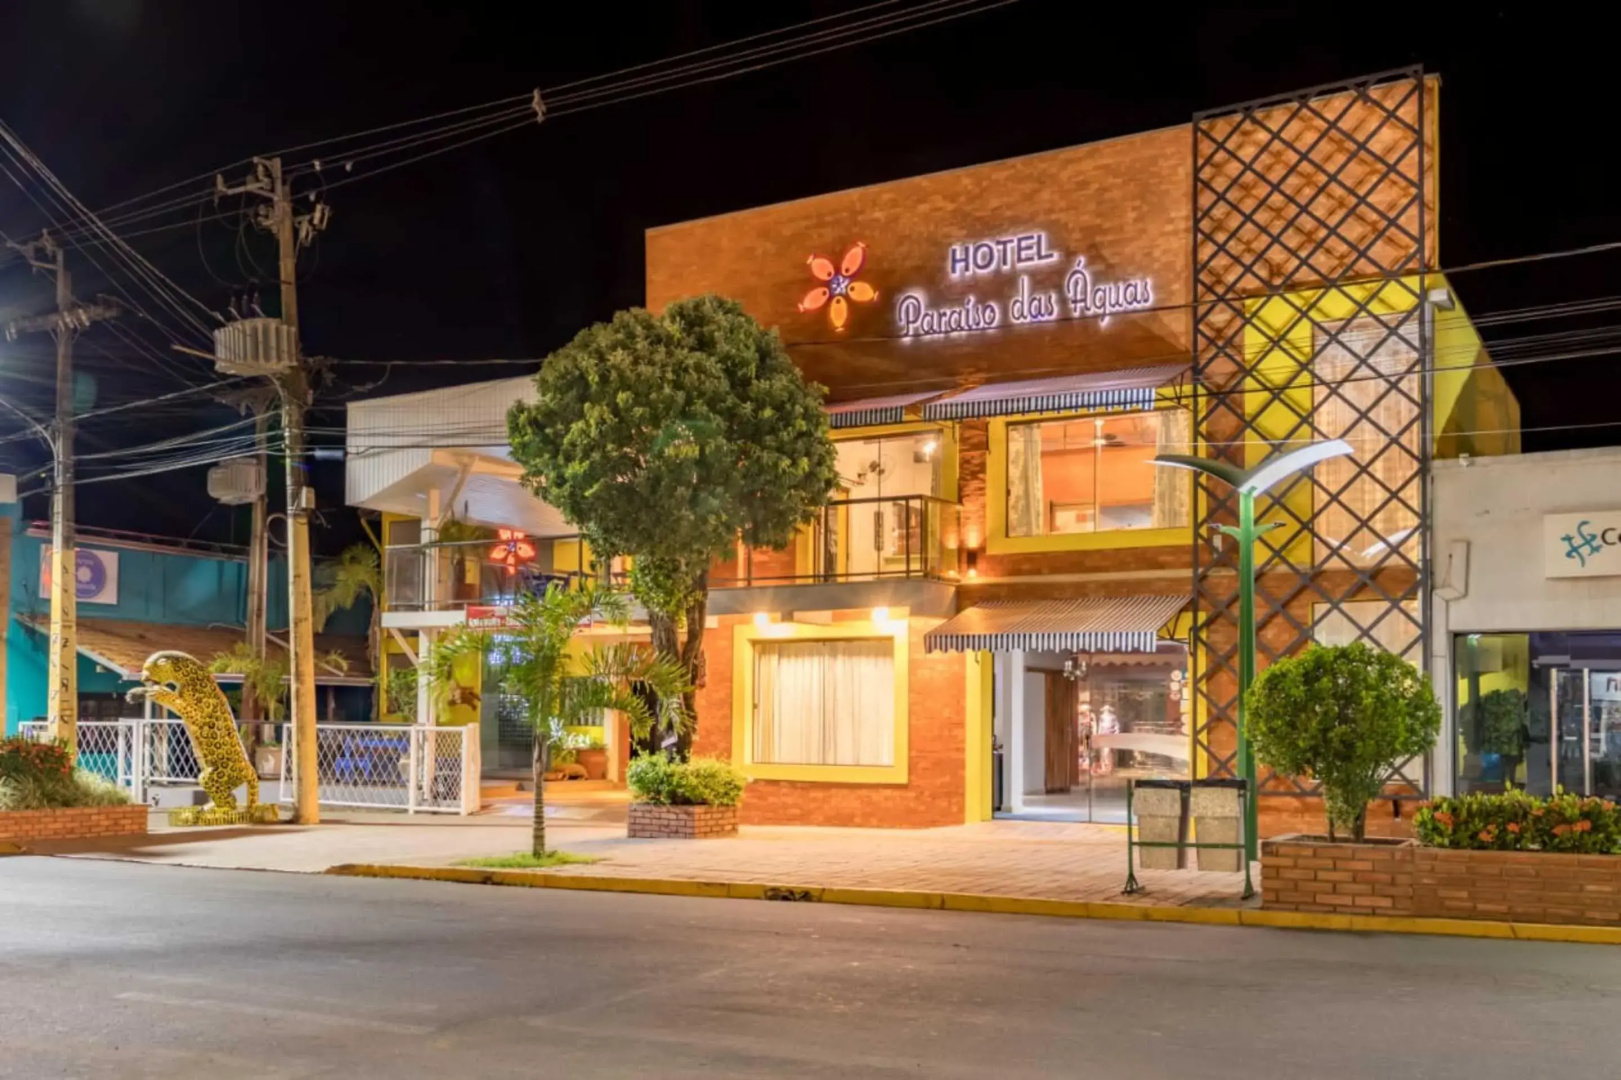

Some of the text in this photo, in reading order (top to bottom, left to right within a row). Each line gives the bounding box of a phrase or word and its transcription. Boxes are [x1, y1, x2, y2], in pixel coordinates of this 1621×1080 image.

[950, 232, 1055, 275] HOTEL
[898, 257, 1152, 338] Paraíso das Águas
